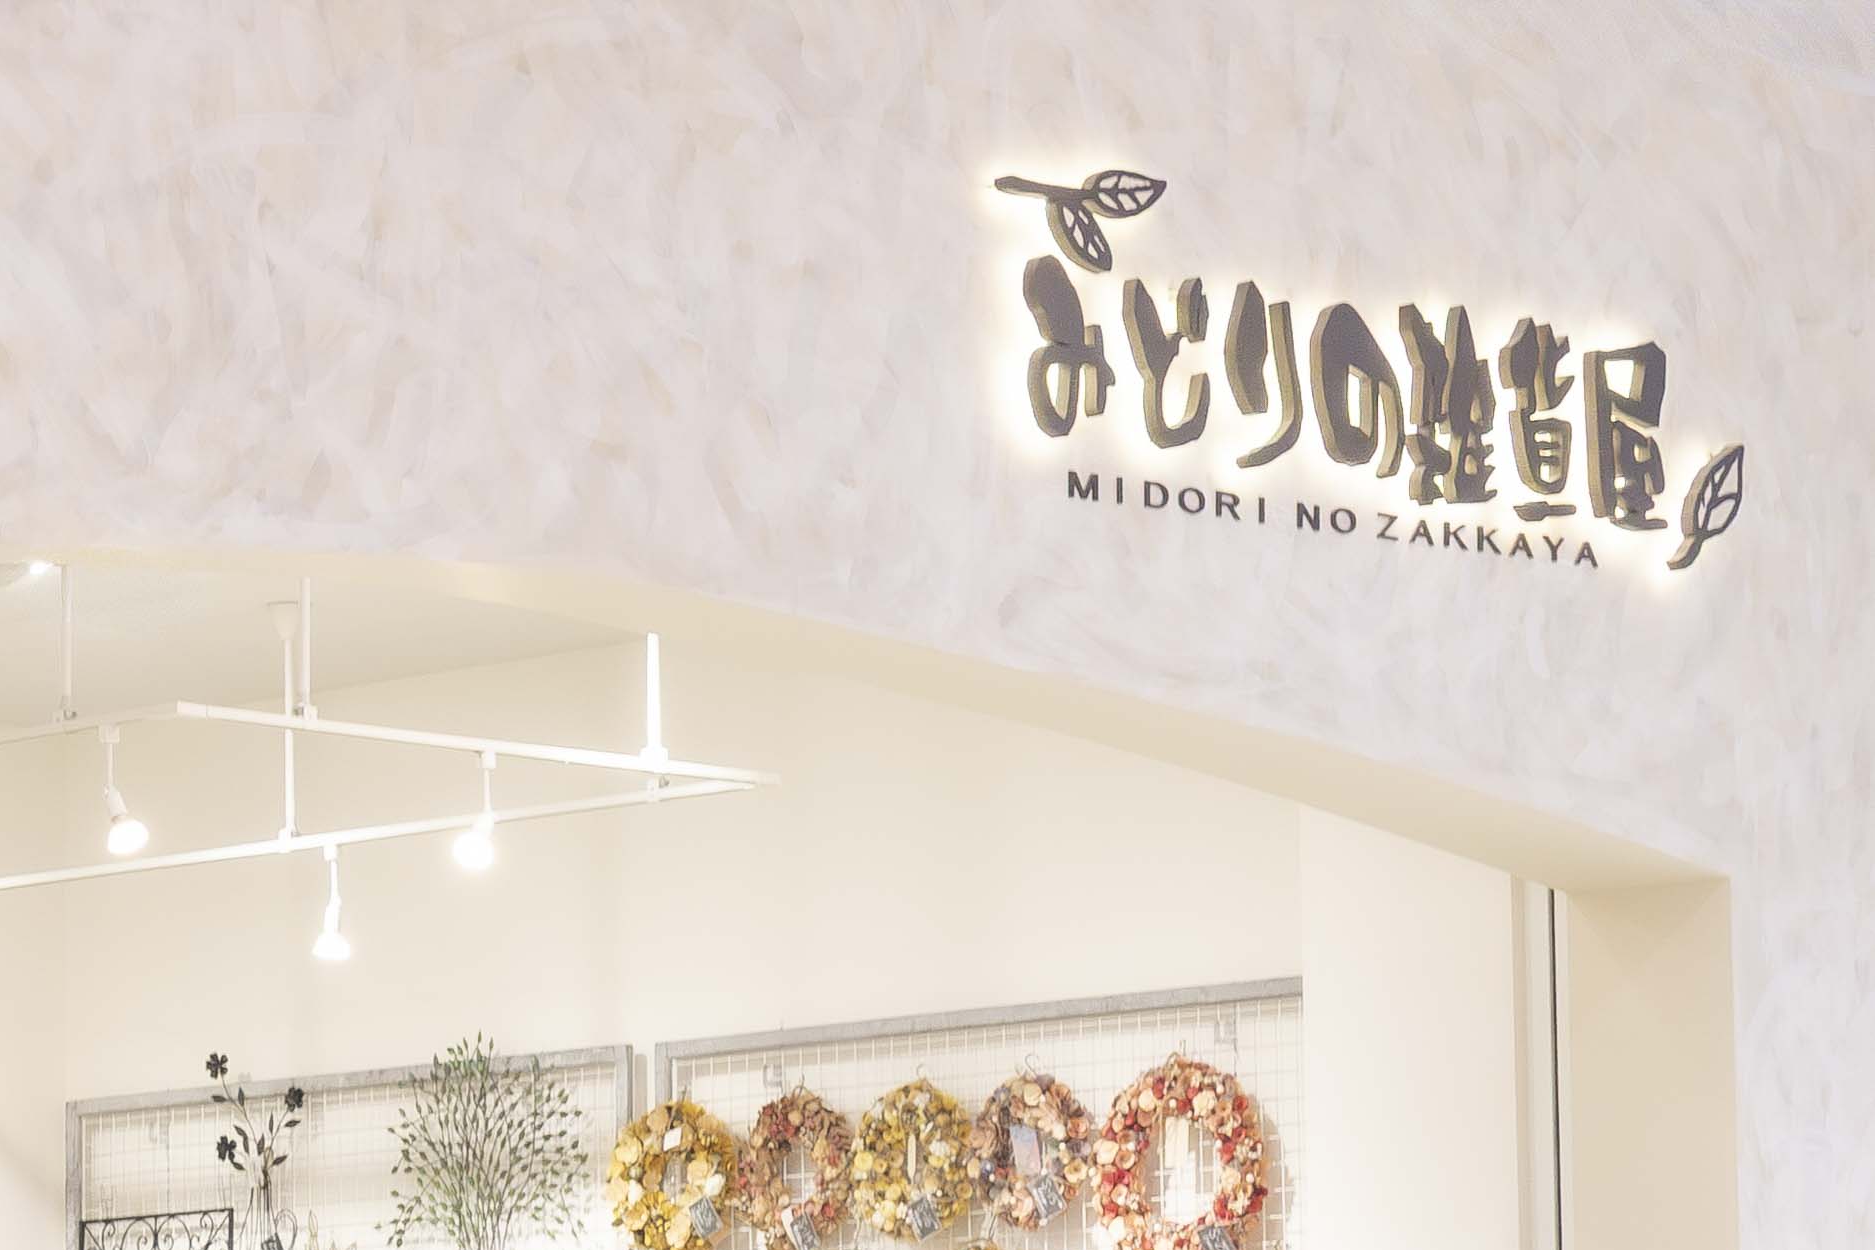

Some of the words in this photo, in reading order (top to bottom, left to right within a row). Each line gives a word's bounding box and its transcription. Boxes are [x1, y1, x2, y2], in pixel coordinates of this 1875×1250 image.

[1067, 470, 1266, 524] MIDORI
[1296, 502, 1358, 534] NO
[1376, 512, 1600, 569] ZAKKAYA
